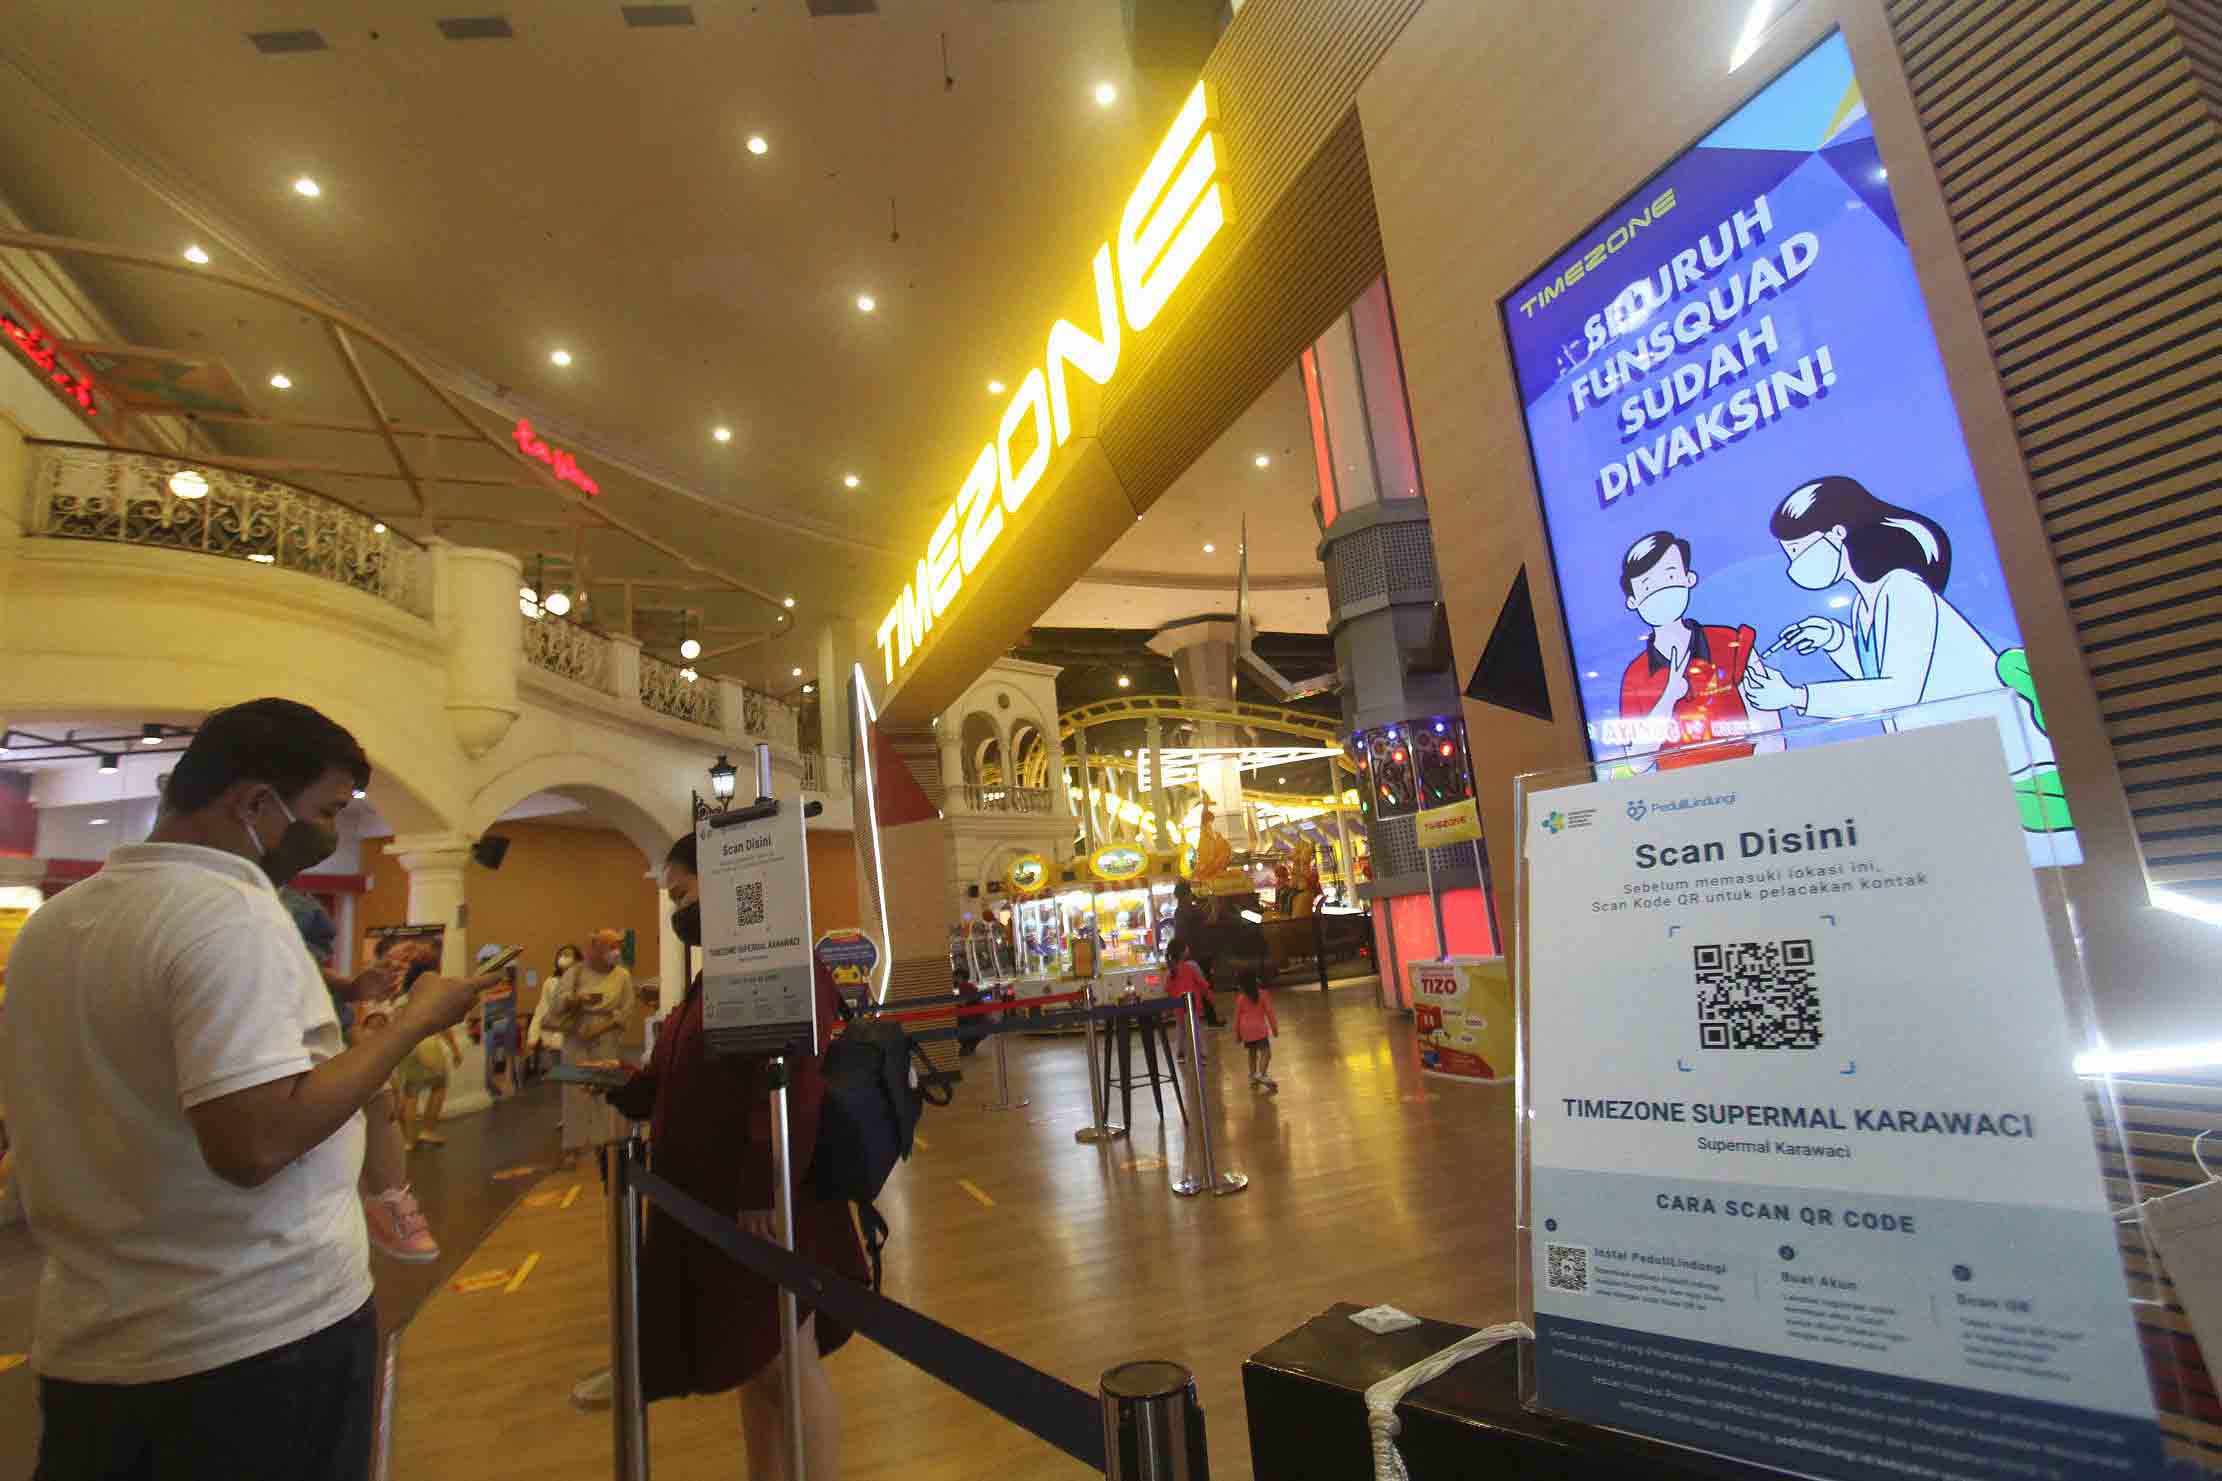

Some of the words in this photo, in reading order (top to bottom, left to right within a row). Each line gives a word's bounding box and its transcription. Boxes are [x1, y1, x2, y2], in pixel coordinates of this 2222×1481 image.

[1520, 187, 1677, 319] TIMEZONE
[1571, 231, 1820, 412] FUNSQUAD
[875, 79, 1226, 686] TIMEZONE
[1621, 315, 1779, 437] SUDAH
[1599, 345, 1838, 503] DIVAKSIN!
[1635, 840, 1725, 870] Scan
[1739, 818, 1858, 859] Disini
[1591, 901, 1628, 913] Scan
[1633, 896, 1672, 911] Kode
[1677, 893, 1701, 907] QR
[1705, 888, 1754, 905] untuk
[1759, 880, 1853, 901] pelacakan
[1860, 872, 1929, 891] kontak
[1623, 879, 1689, 895] Sebelum
[1695, 870, 1782, 888] memasuki
[1788, 863, 1844, 880] lokasi
[1421, 978, 1457, 994] TIZO
[1562, 1096, 1685, 1124] TIMEZONE
[1692, 1103, 1847, 1132] SUPERMAL
[1853, 1108, 2034, 1139] KARAWACI
[1697, 1136, 1770, 1155] Supermal
[1775, 1140, 1852, 1159] Karawaci
[1656, 1193, 1717, 1216] CARA
[1725, 1200, 1791, 1223] SCAN
[1800, 1206, 1834, 1227] QR
[1844, 1211, 1917, 1234] CODE
